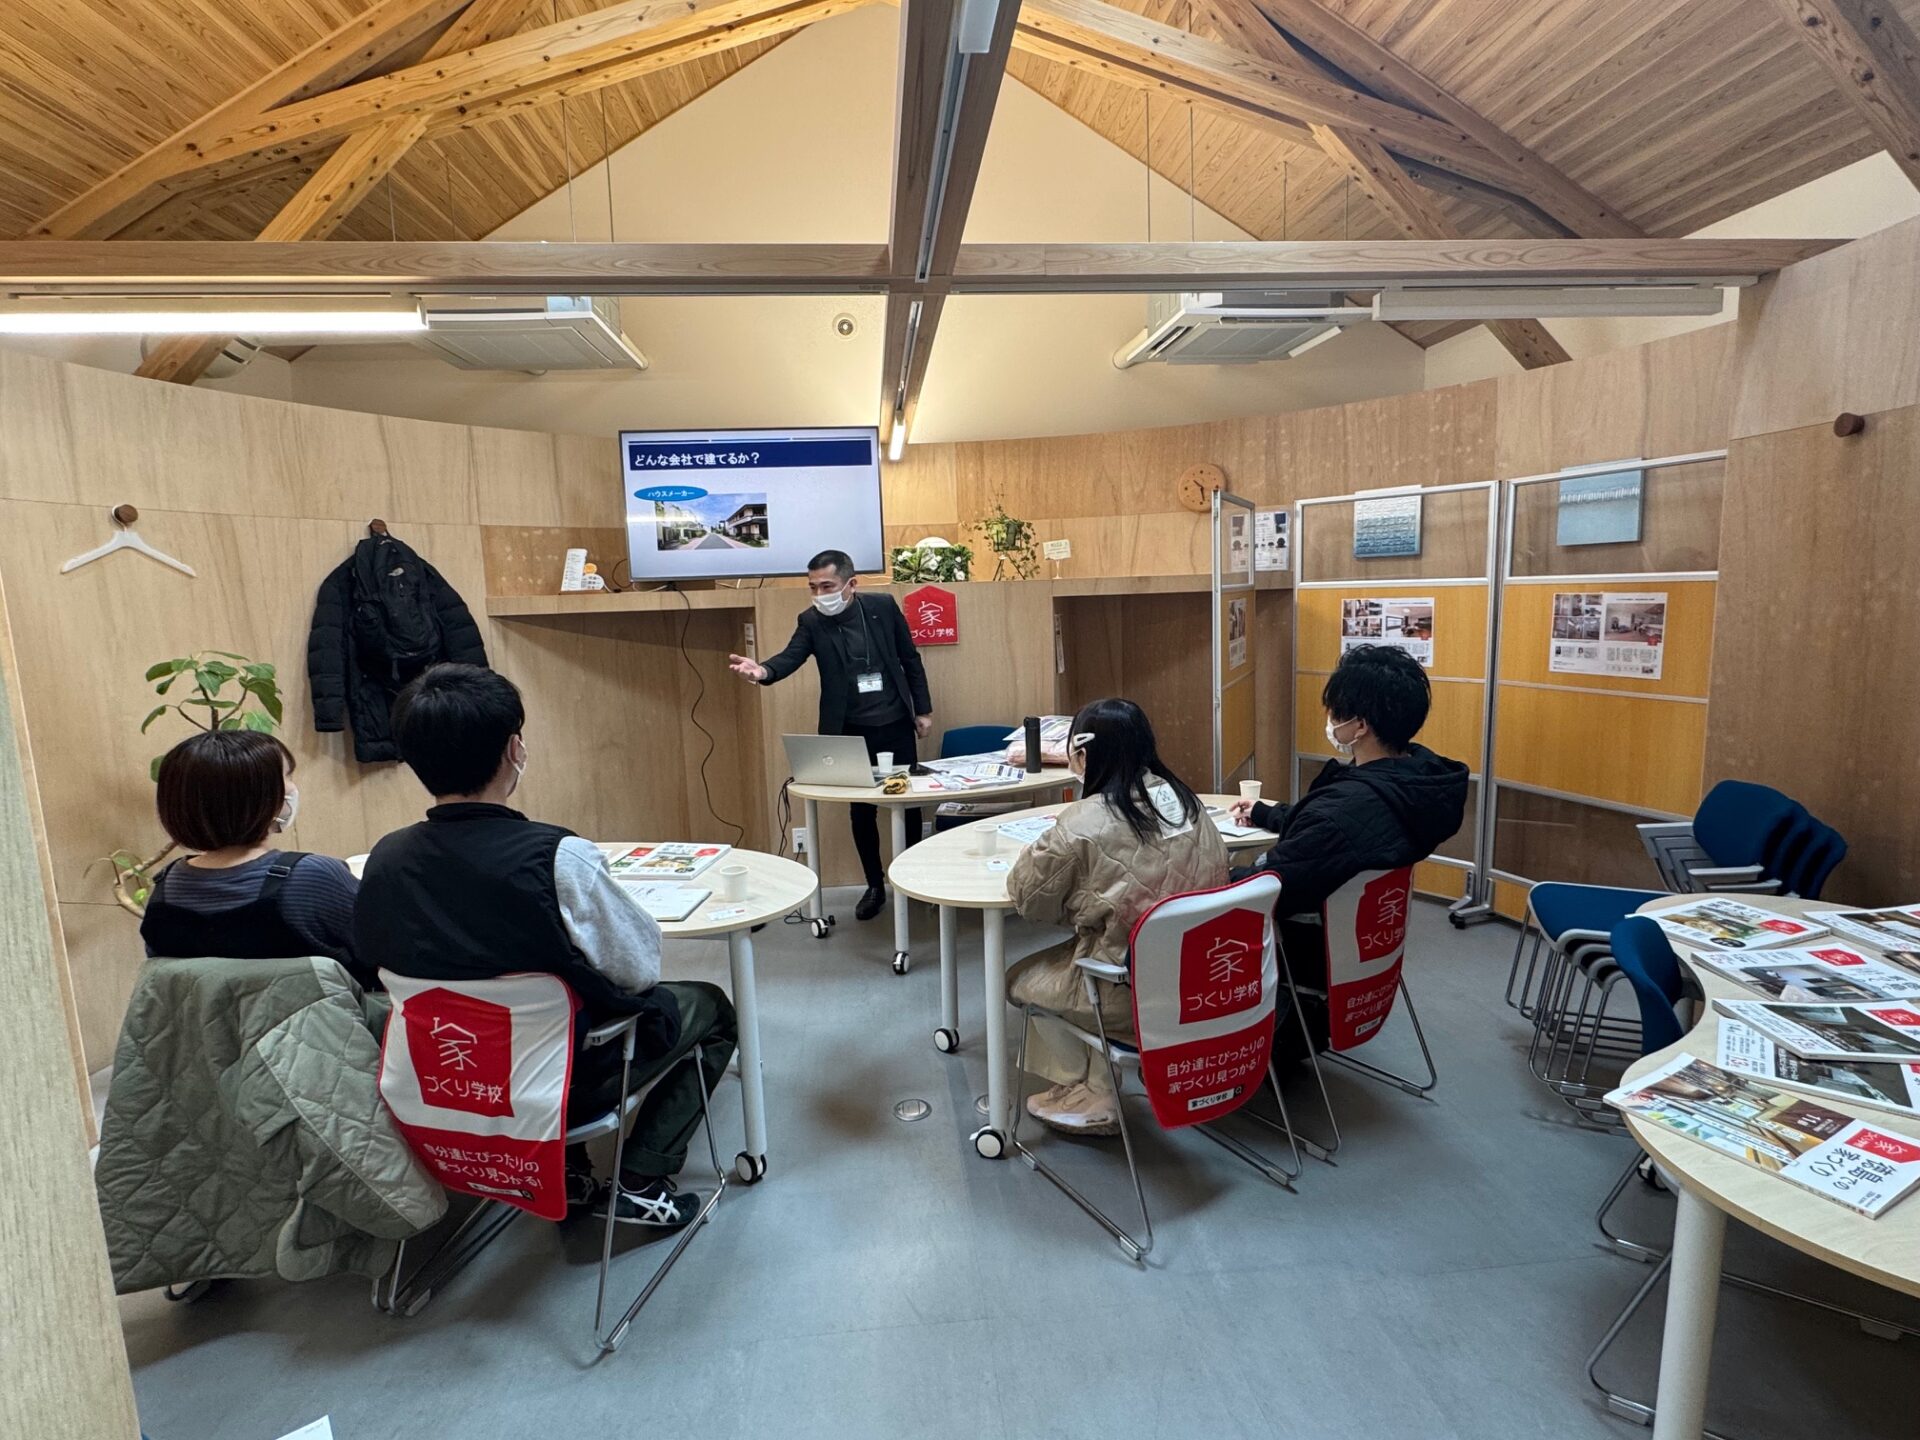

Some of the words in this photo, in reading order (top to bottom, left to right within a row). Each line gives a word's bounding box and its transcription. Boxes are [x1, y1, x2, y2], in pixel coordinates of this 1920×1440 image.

[635, 452, 760, 467] どんな会社で建てるか?
[648, 490, 695, 498] ハウスメーカー
[918, 600, 944, 626] 家
[911, 628, 955, 639] づくり学校
[1377, 888, 1406, 925] 家
[1206, 937, 1249, 983] 家
[1187, 980, 1260, 1011] づくり学校
[429, 1016, 478, 1071] 家
[424, 1076, 504, 1104] づくり学校
